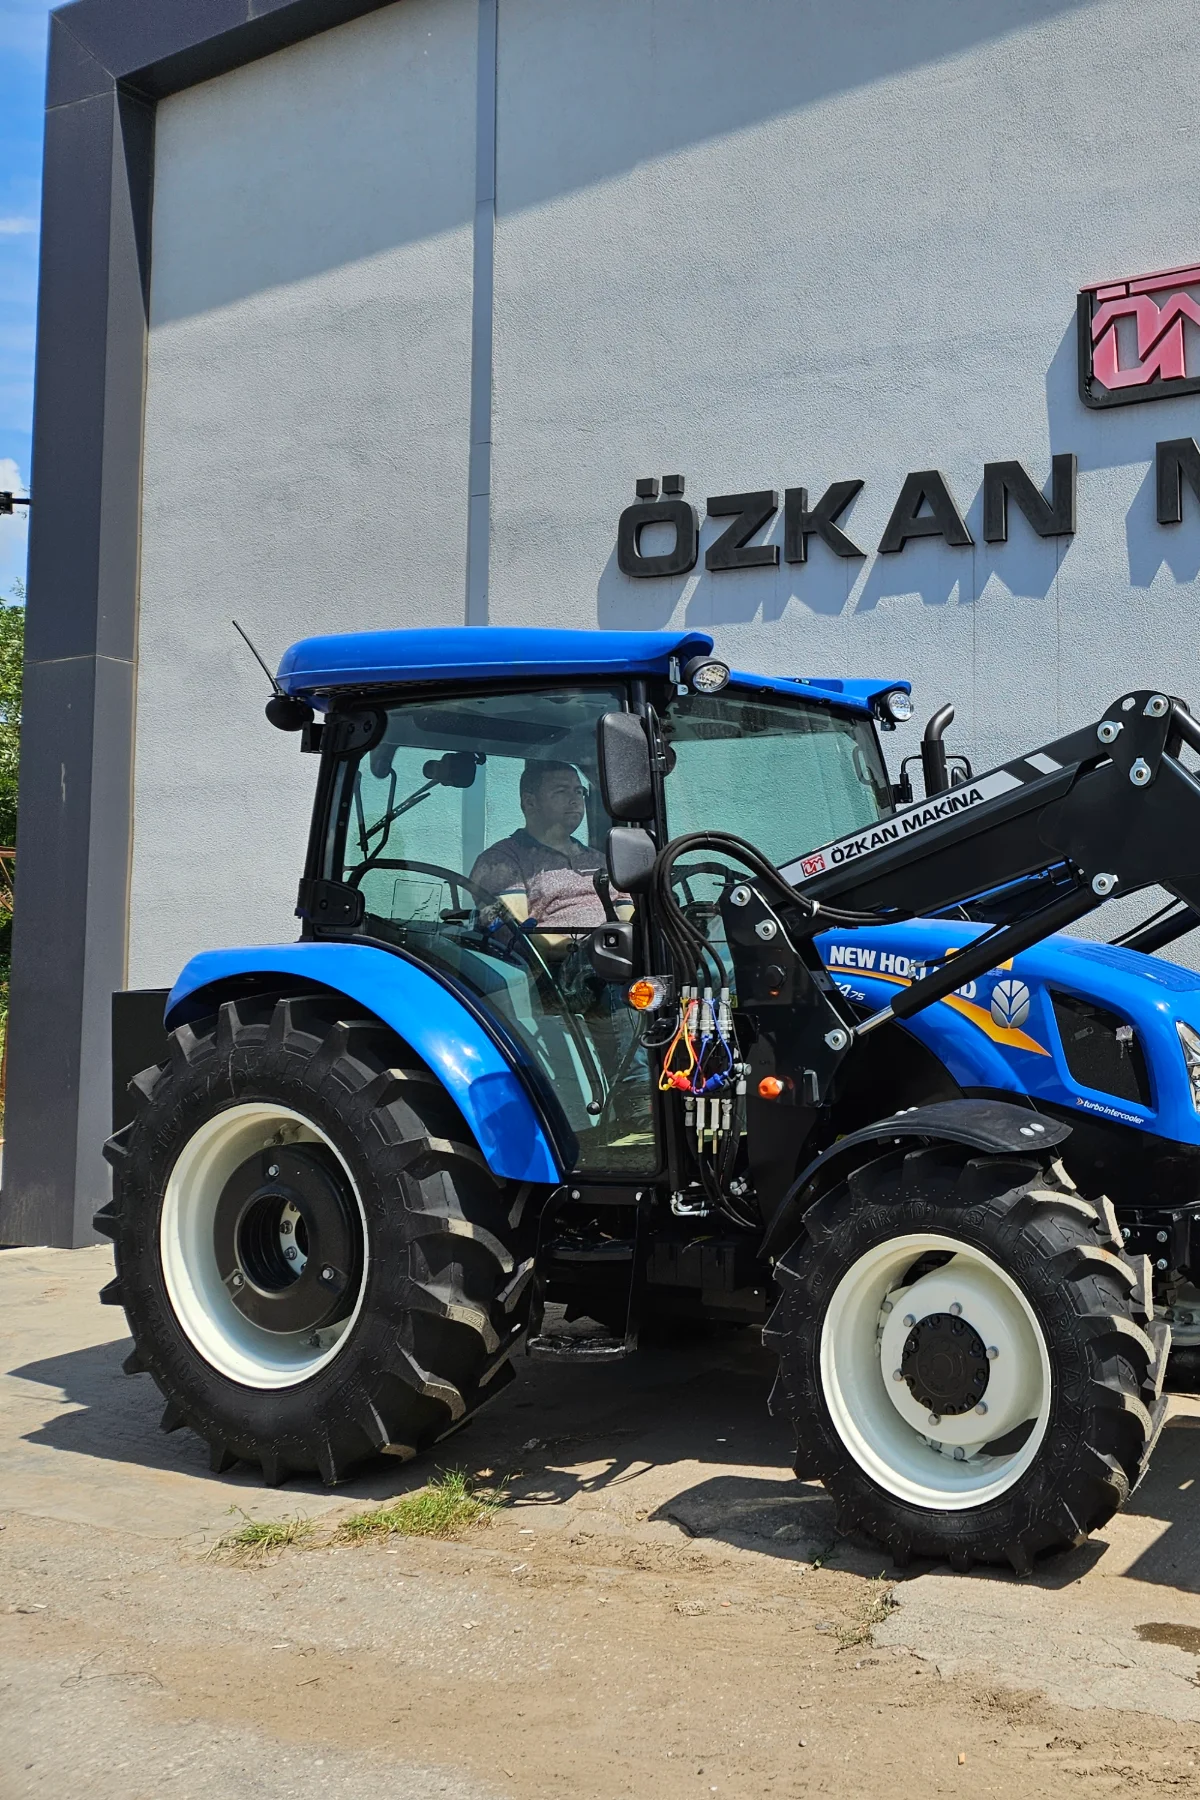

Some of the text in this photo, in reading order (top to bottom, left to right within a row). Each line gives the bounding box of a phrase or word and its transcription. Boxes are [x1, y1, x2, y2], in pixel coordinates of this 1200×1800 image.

[617, 453, 1077, 578] ÖZKAN
[831, 788, 984, 864] ÖZKAN MAKİNA
[829, 945, 877, 969] NEW
[1083, 1100, 1145, 1124] turbo intercooler
